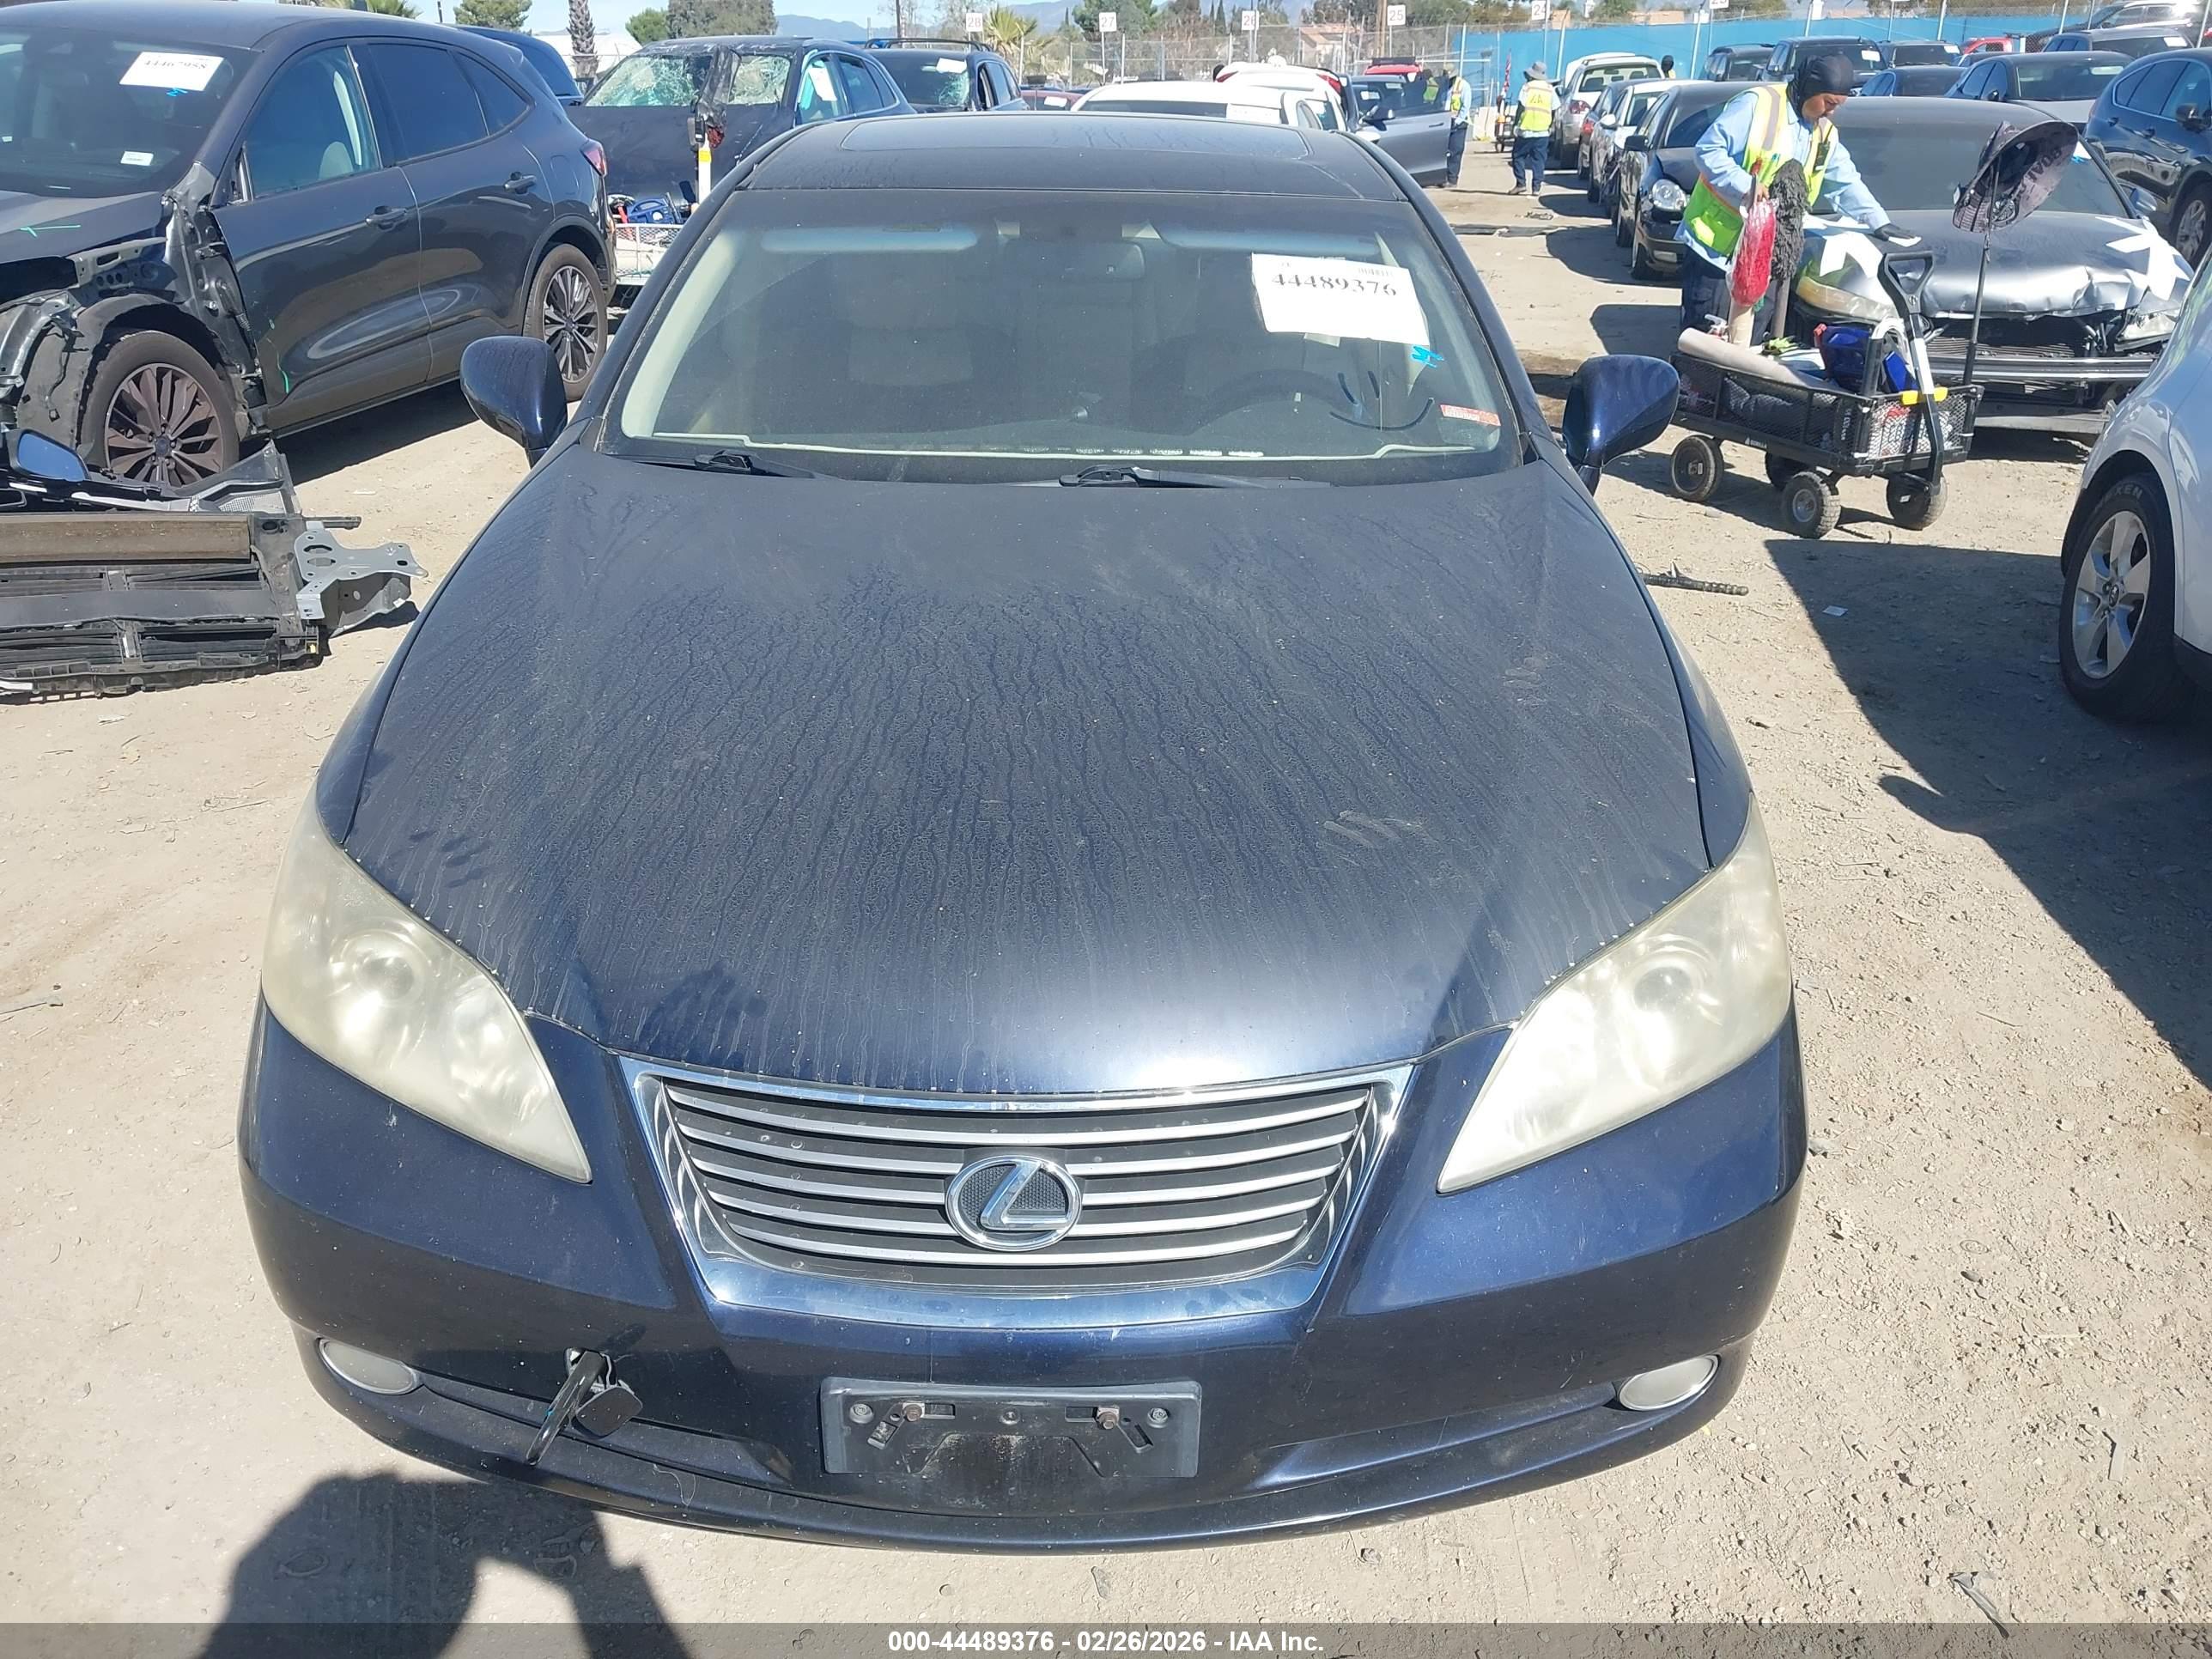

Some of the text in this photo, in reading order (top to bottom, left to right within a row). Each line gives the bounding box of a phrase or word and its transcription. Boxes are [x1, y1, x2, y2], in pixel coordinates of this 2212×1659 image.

[1389, 9, 1404, 21] 25
[968, 17, 981, 27] 28
[1101, 16, 1115, 27] 27
[1271, 273, 1397, 296] 44489376
